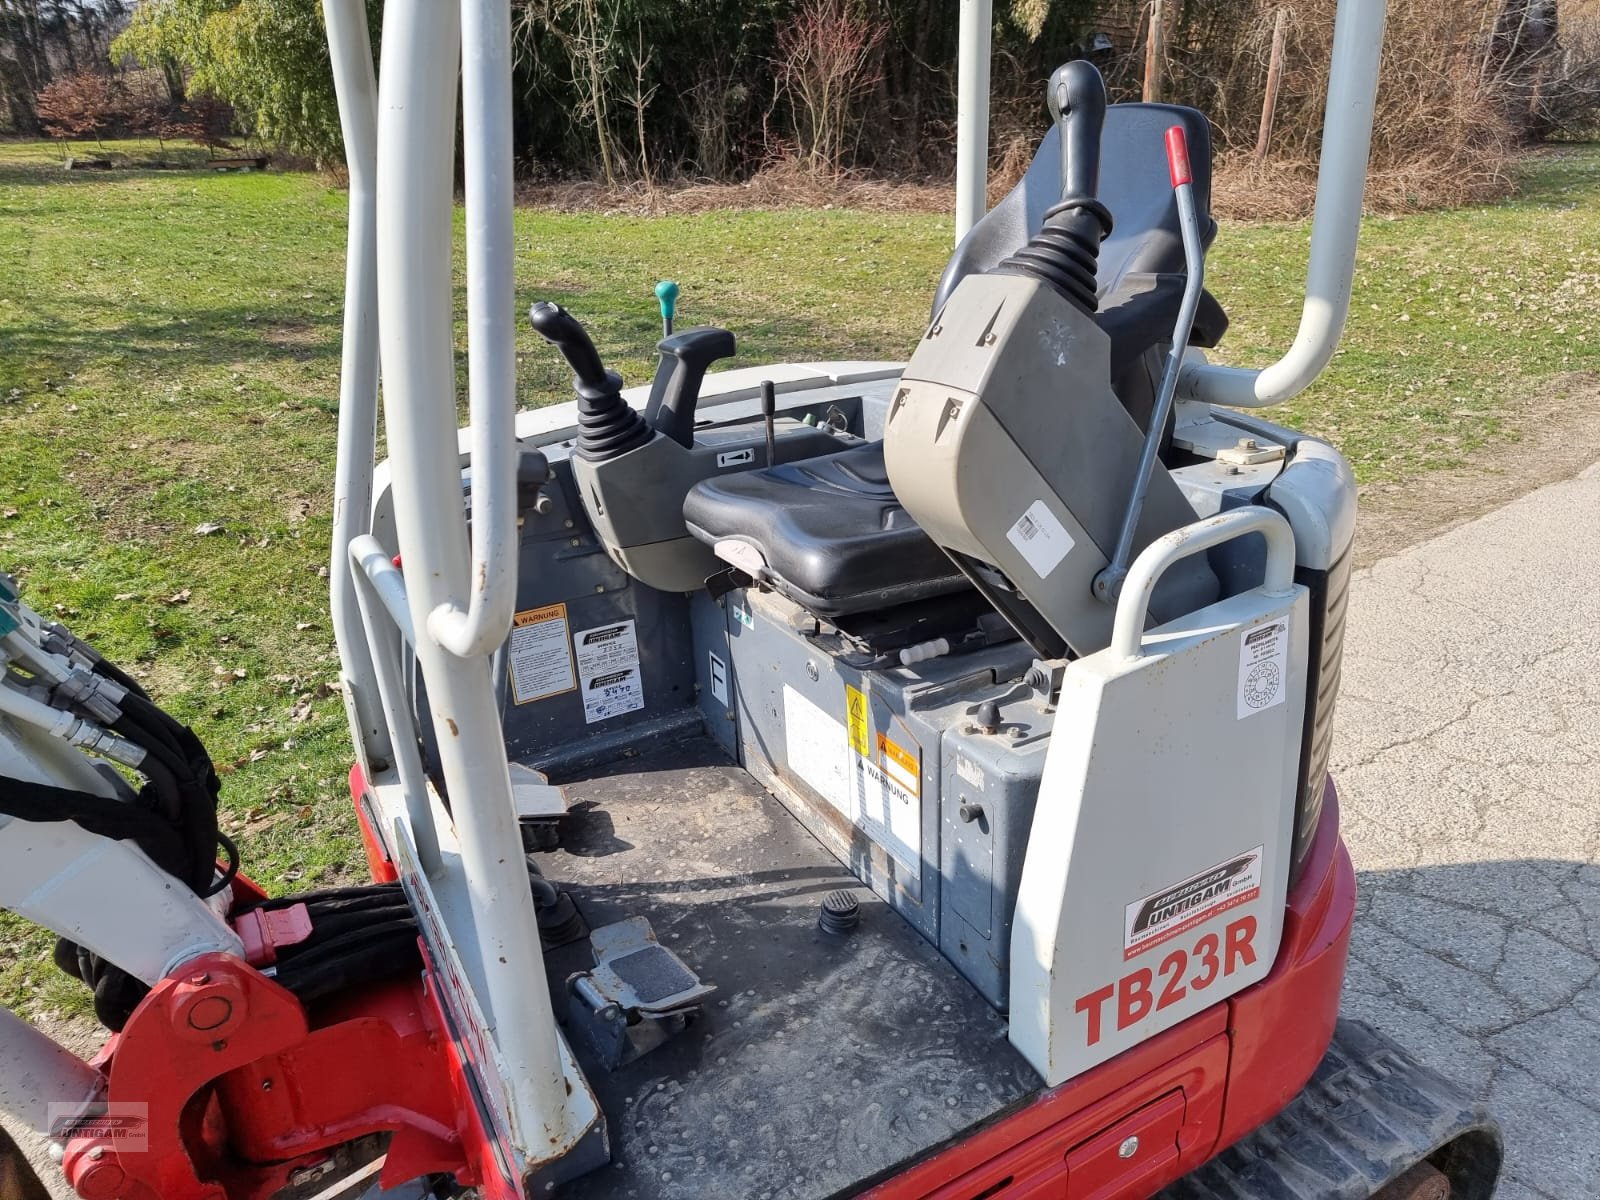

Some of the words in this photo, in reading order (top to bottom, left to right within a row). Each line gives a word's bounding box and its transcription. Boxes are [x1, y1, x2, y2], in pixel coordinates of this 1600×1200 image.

[521, 609, 559, 623] WARNUNG
[711, 655, 723, 694] F
[867, 764, 909, 806] WARNUNG
[1075, 915, 1258, 1047] TB23R
